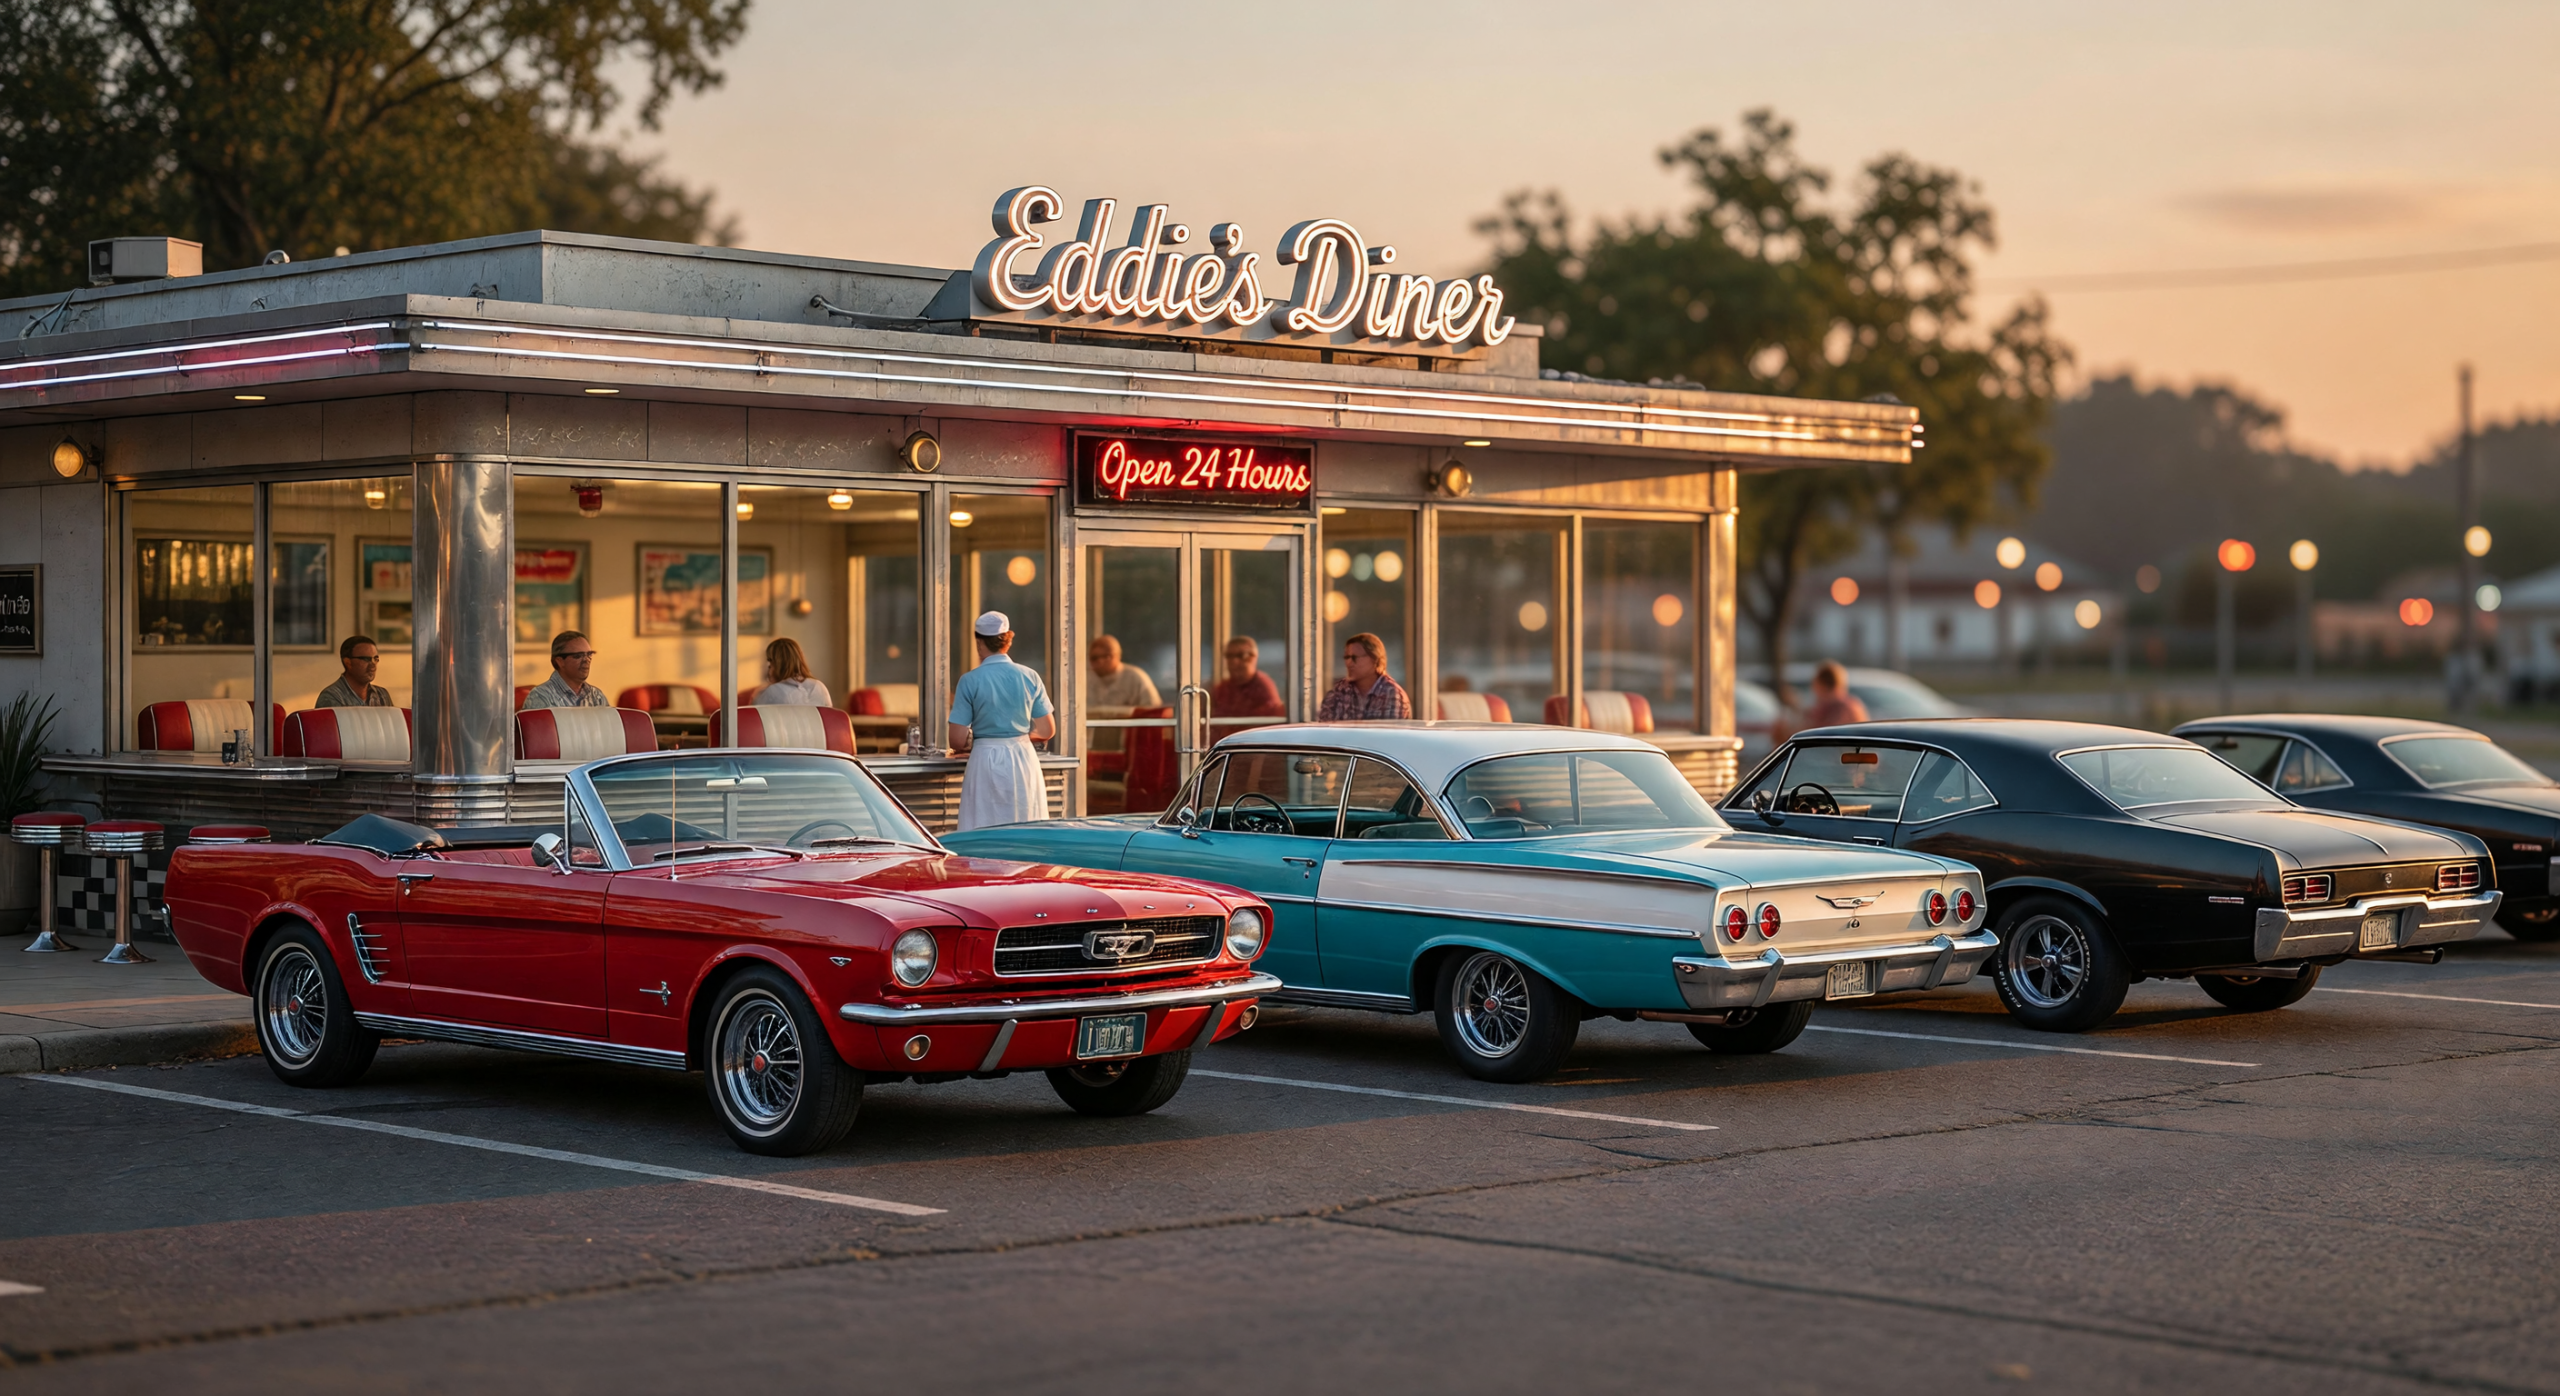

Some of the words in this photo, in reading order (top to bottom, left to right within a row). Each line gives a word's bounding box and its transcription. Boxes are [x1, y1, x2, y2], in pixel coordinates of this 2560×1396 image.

[983, 184, 1274, 326] Eddie's
[1284, 218, 1517, 347] Diner
[1101, 440, 1176, 499] Open
[1180, 447, 1221, 488] 24
[1226, 447, 1311, 492] Hours
